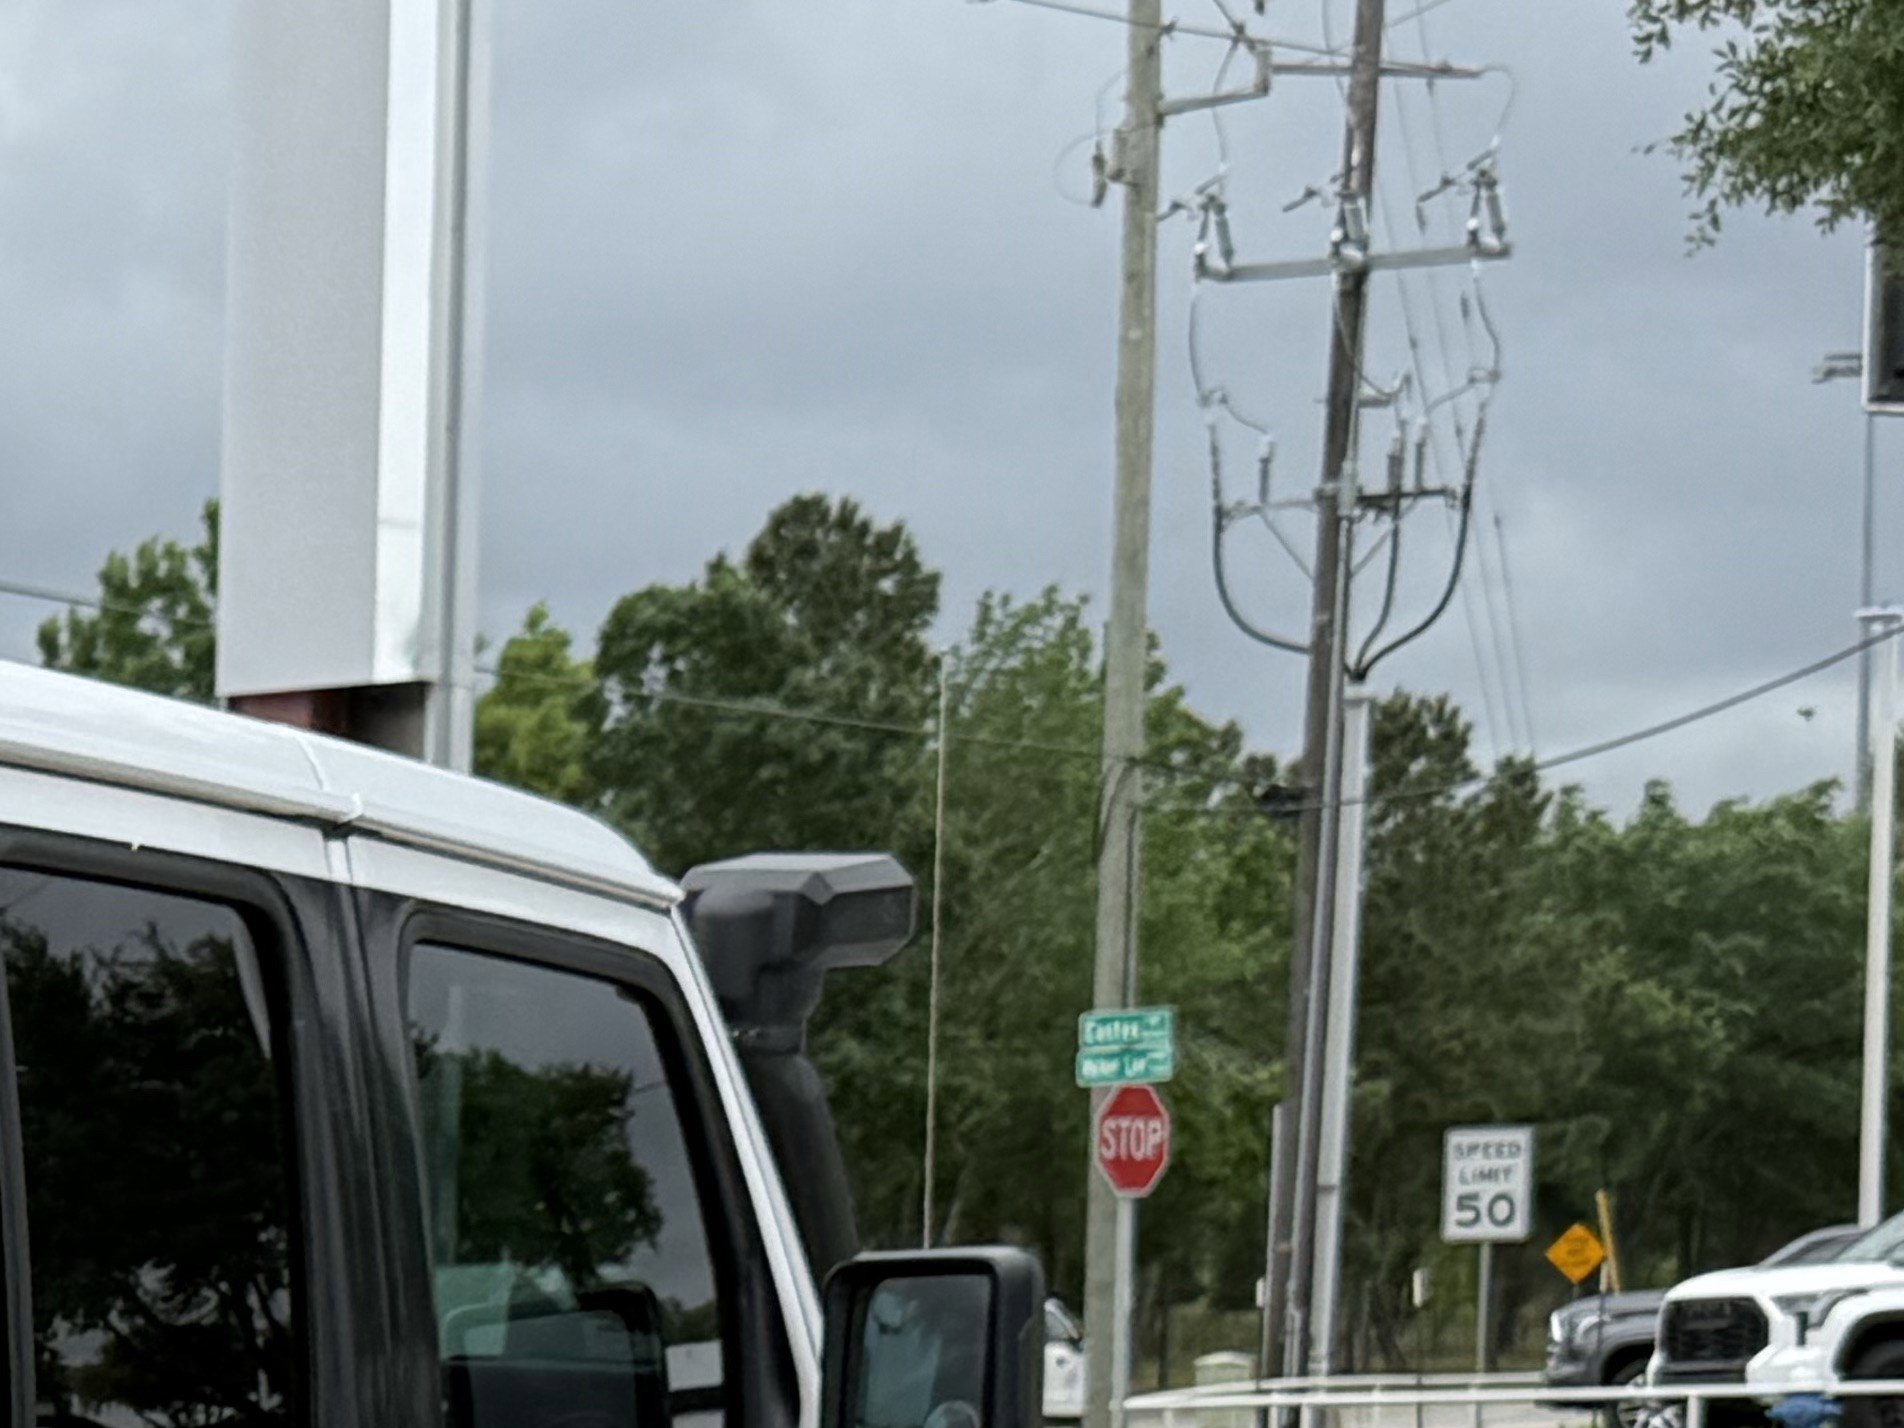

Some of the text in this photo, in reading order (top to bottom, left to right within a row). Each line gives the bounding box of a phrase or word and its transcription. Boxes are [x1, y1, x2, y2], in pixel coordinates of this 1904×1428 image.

[1100, 1117, 1162, 1161] STOP
[1453, 1140, 1522, 1161] SPEED
[1458, 1164, 1513, 1186] LIMIT
[1455, 1191, 1516, 1228] 50
